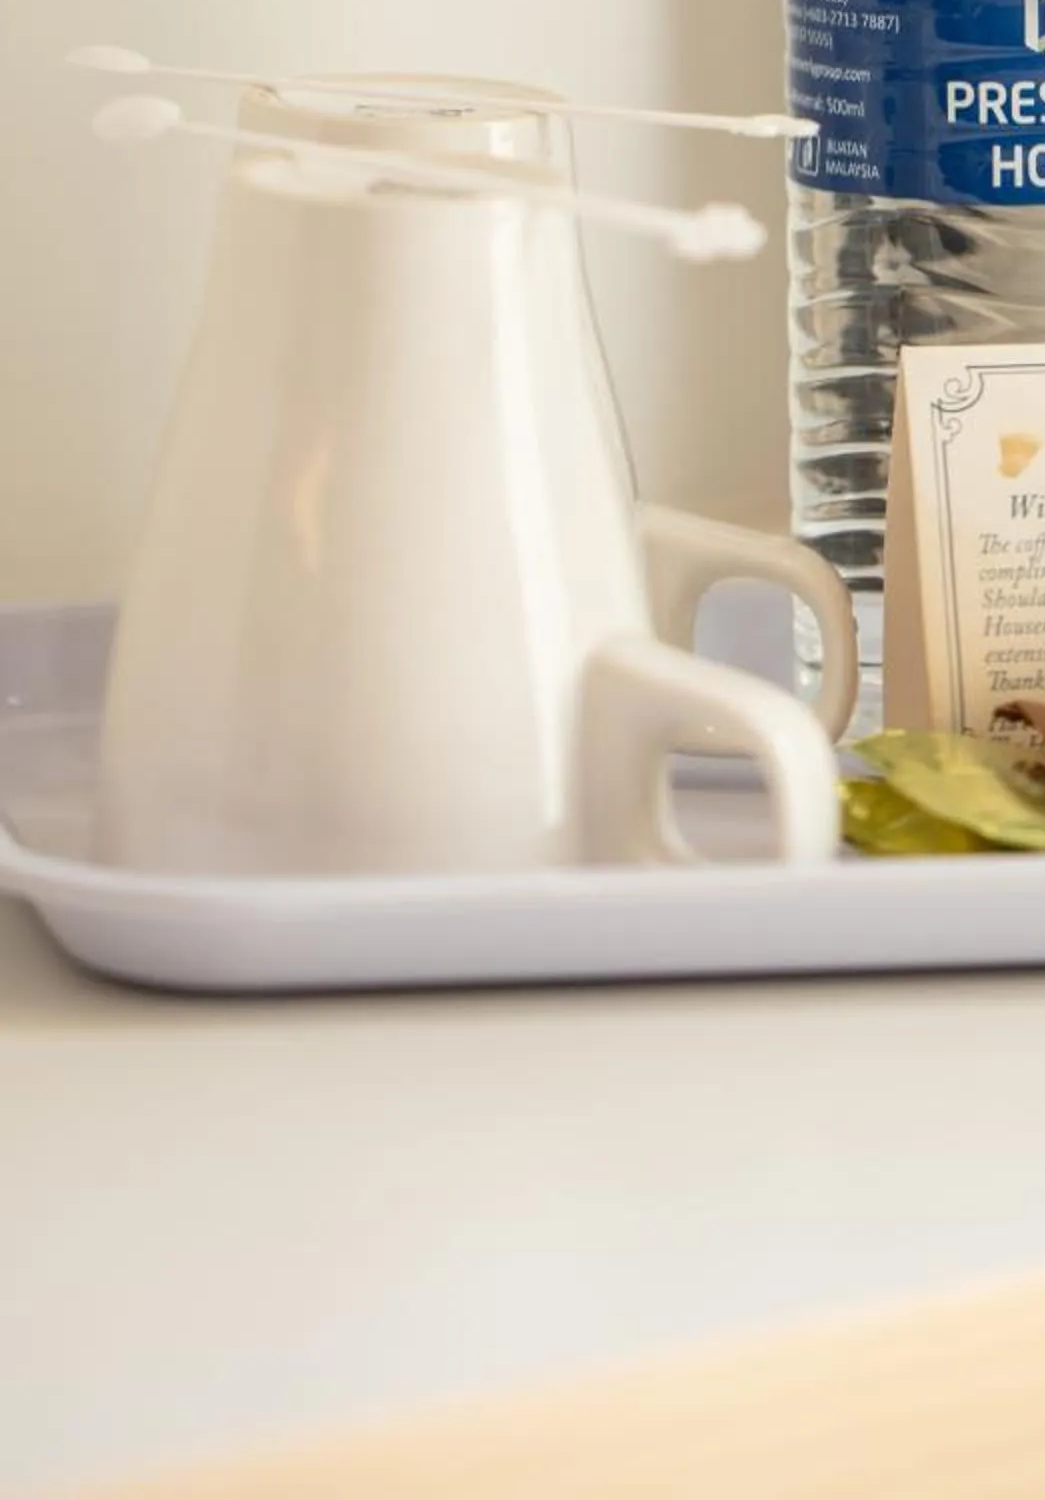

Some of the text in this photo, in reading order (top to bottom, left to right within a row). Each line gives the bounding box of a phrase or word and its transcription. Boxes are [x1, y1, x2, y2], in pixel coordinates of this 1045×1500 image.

[827, 138, 867, 159] BUATAN
[825, 160, 880, 181] MALAYSIA
[979, 531, 1010, 555] The
[988, 668, 1045, 693] Thank
